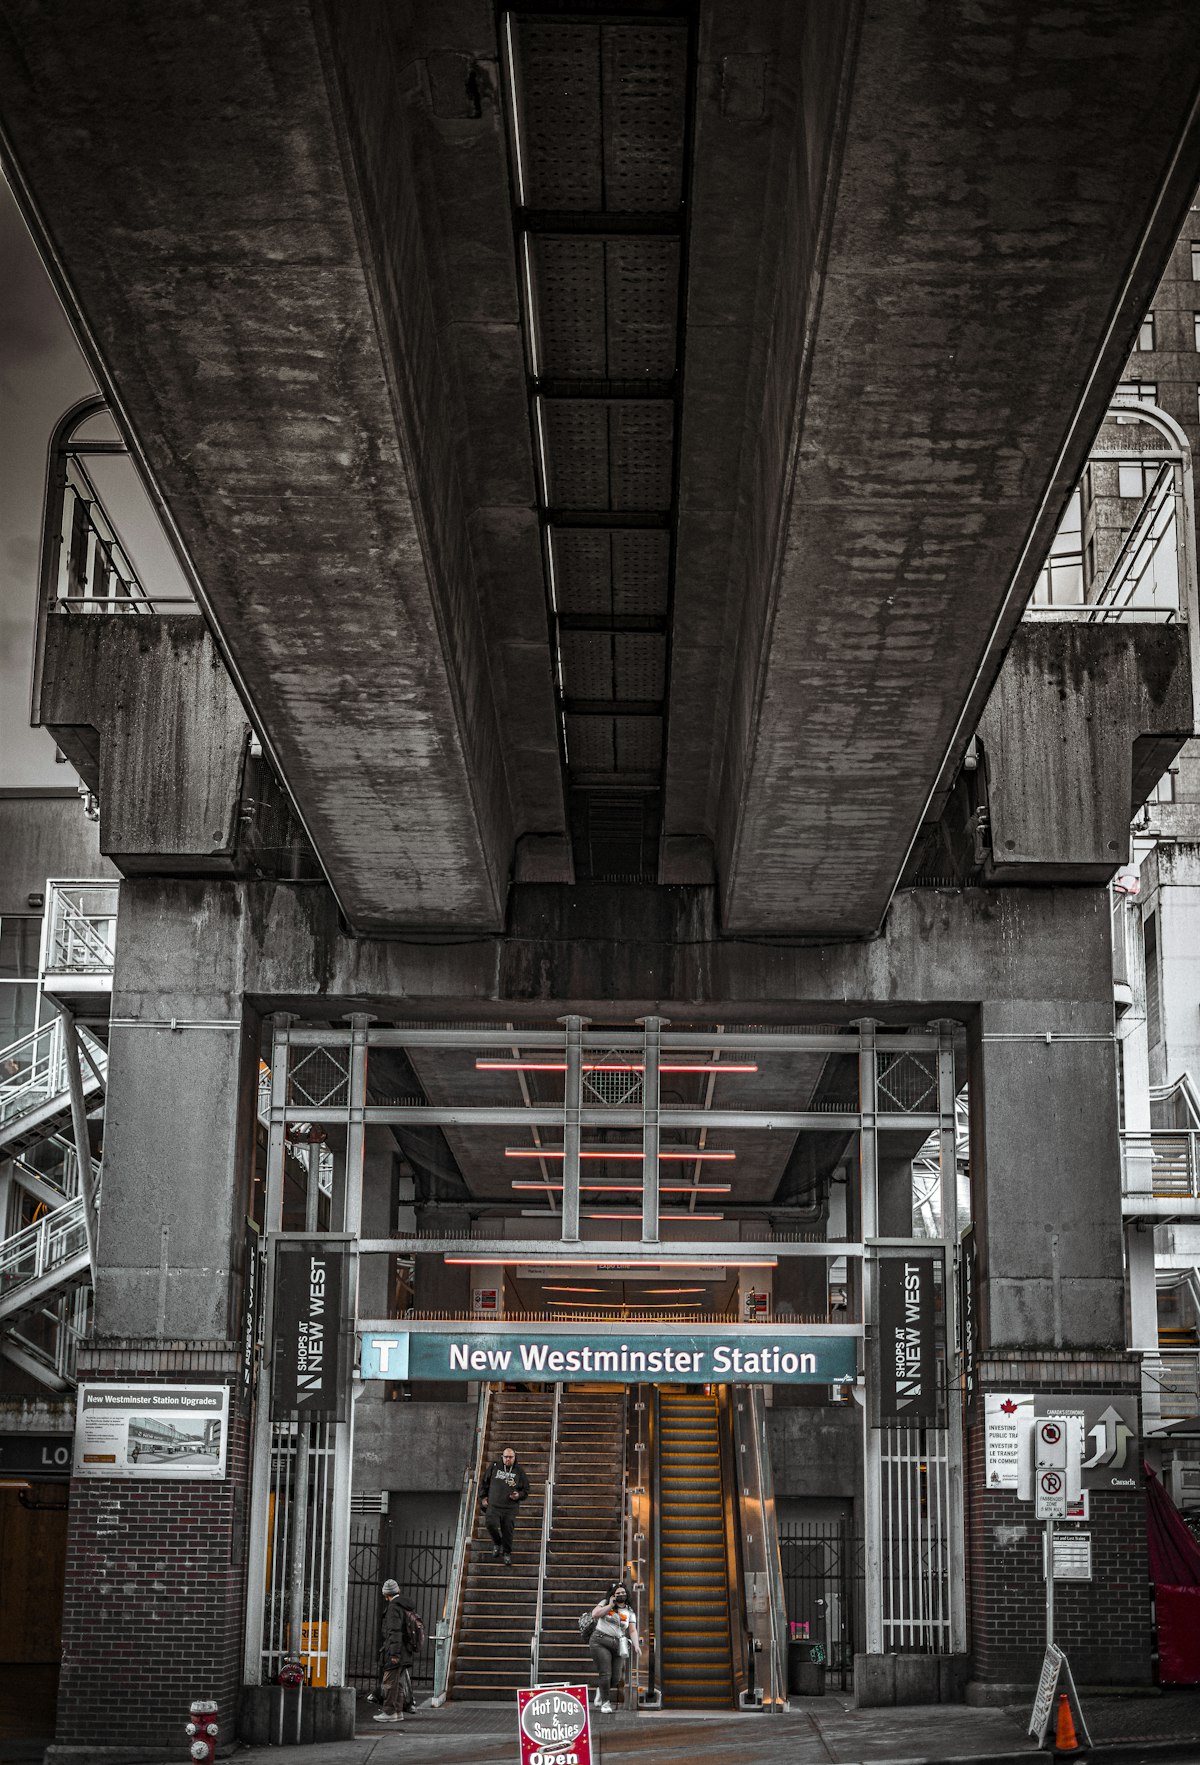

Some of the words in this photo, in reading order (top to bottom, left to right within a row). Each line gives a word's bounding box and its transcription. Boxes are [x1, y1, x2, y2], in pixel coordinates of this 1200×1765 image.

[309, 1257, 326, 1317] WEST
[905, 1263, 921, 1323] WEST
[298, 1321, 309, 1333] AT
[895, 1327, 905, 1339] AT
[297, 1335, 308, 1371] SHOPS
[308, 1322, 324, 1372] NEW
[371, 1339, 399, 1372] T
[905, 1327, 921, 1378] NEW
[450, 1344, 512, 1370] New
[519, 1344, 705, 1372] Westminster
[712, 1346, 817, 1373] Station
[895, 1341, 906, 1377] SHOPS
[87, 1395, 103, 1403] New
[104, 1395, 151, 1404] Westminster
[151, 1396, 179, 1405] Station
[180, 1397, 217, 1406] Upgrades
[42, 1447, 72, 1465] LO
[1111, 1478, 1136, 1486] Canada
[531, 1699, 551, 1715] Hot
[553, 1696, 579, 1715] Dogs
[552, 1714, 560, 1727] &
[534, 1722, 579, 1740] Smokies
[529, 1752, 578, 1765] Open
